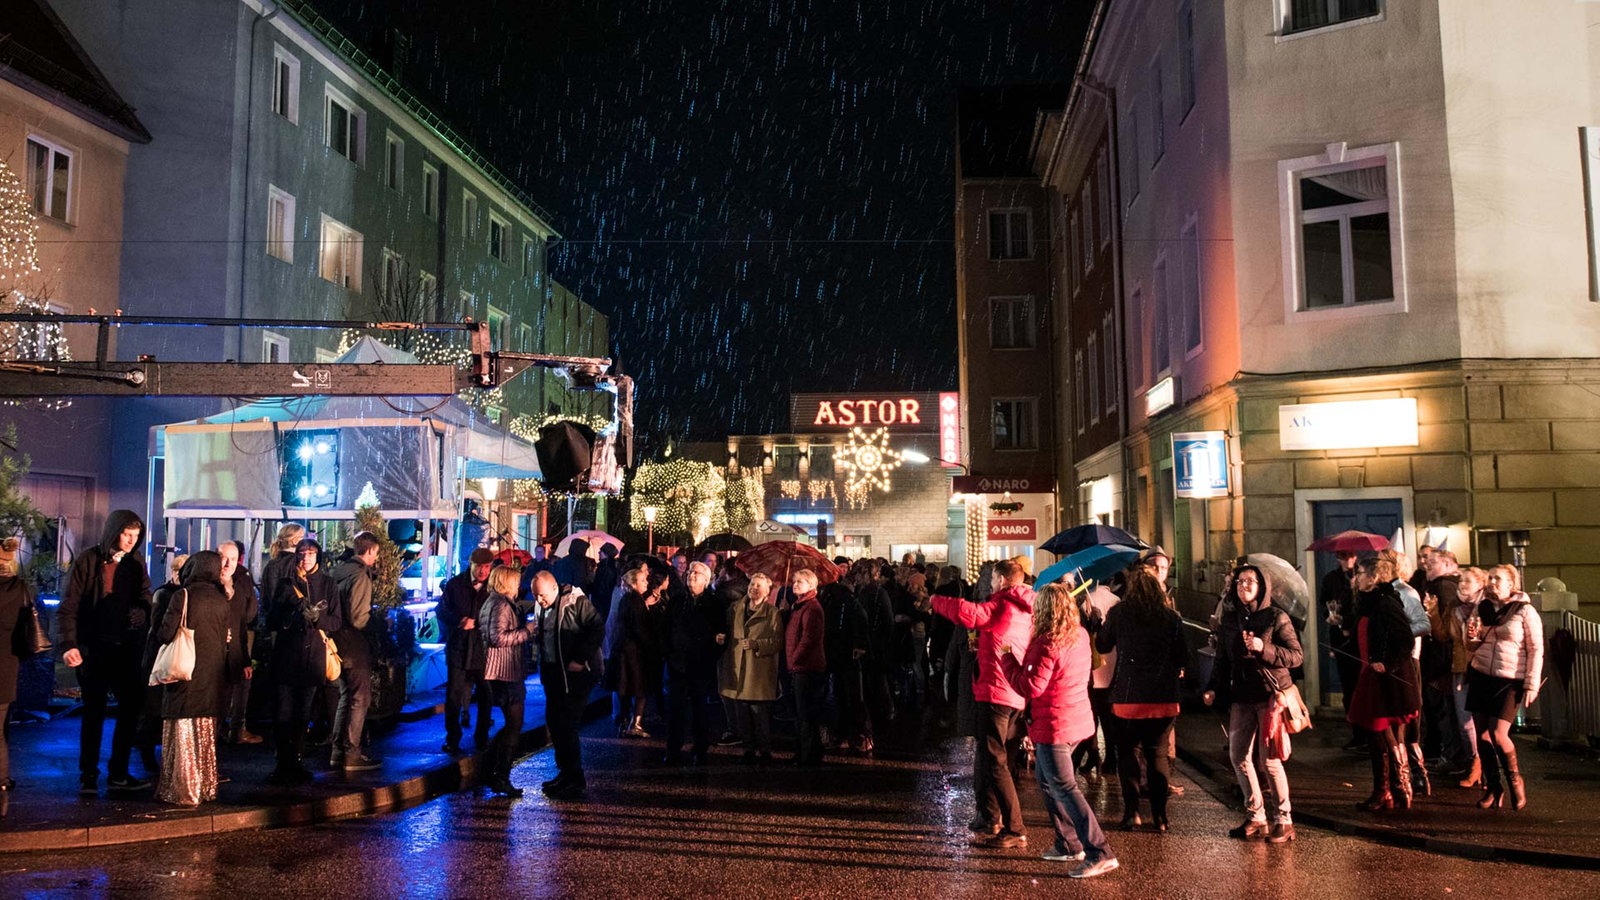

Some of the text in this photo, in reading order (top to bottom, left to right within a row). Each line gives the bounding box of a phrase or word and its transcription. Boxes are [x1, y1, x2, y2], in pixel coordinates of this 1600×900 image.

[813, 398, 921, 426] ASTOR
[943, 412, 957, 464] NARO
[992, 479, 1030, 490] NARO
[1001, 525, 1030, 535] NARO
